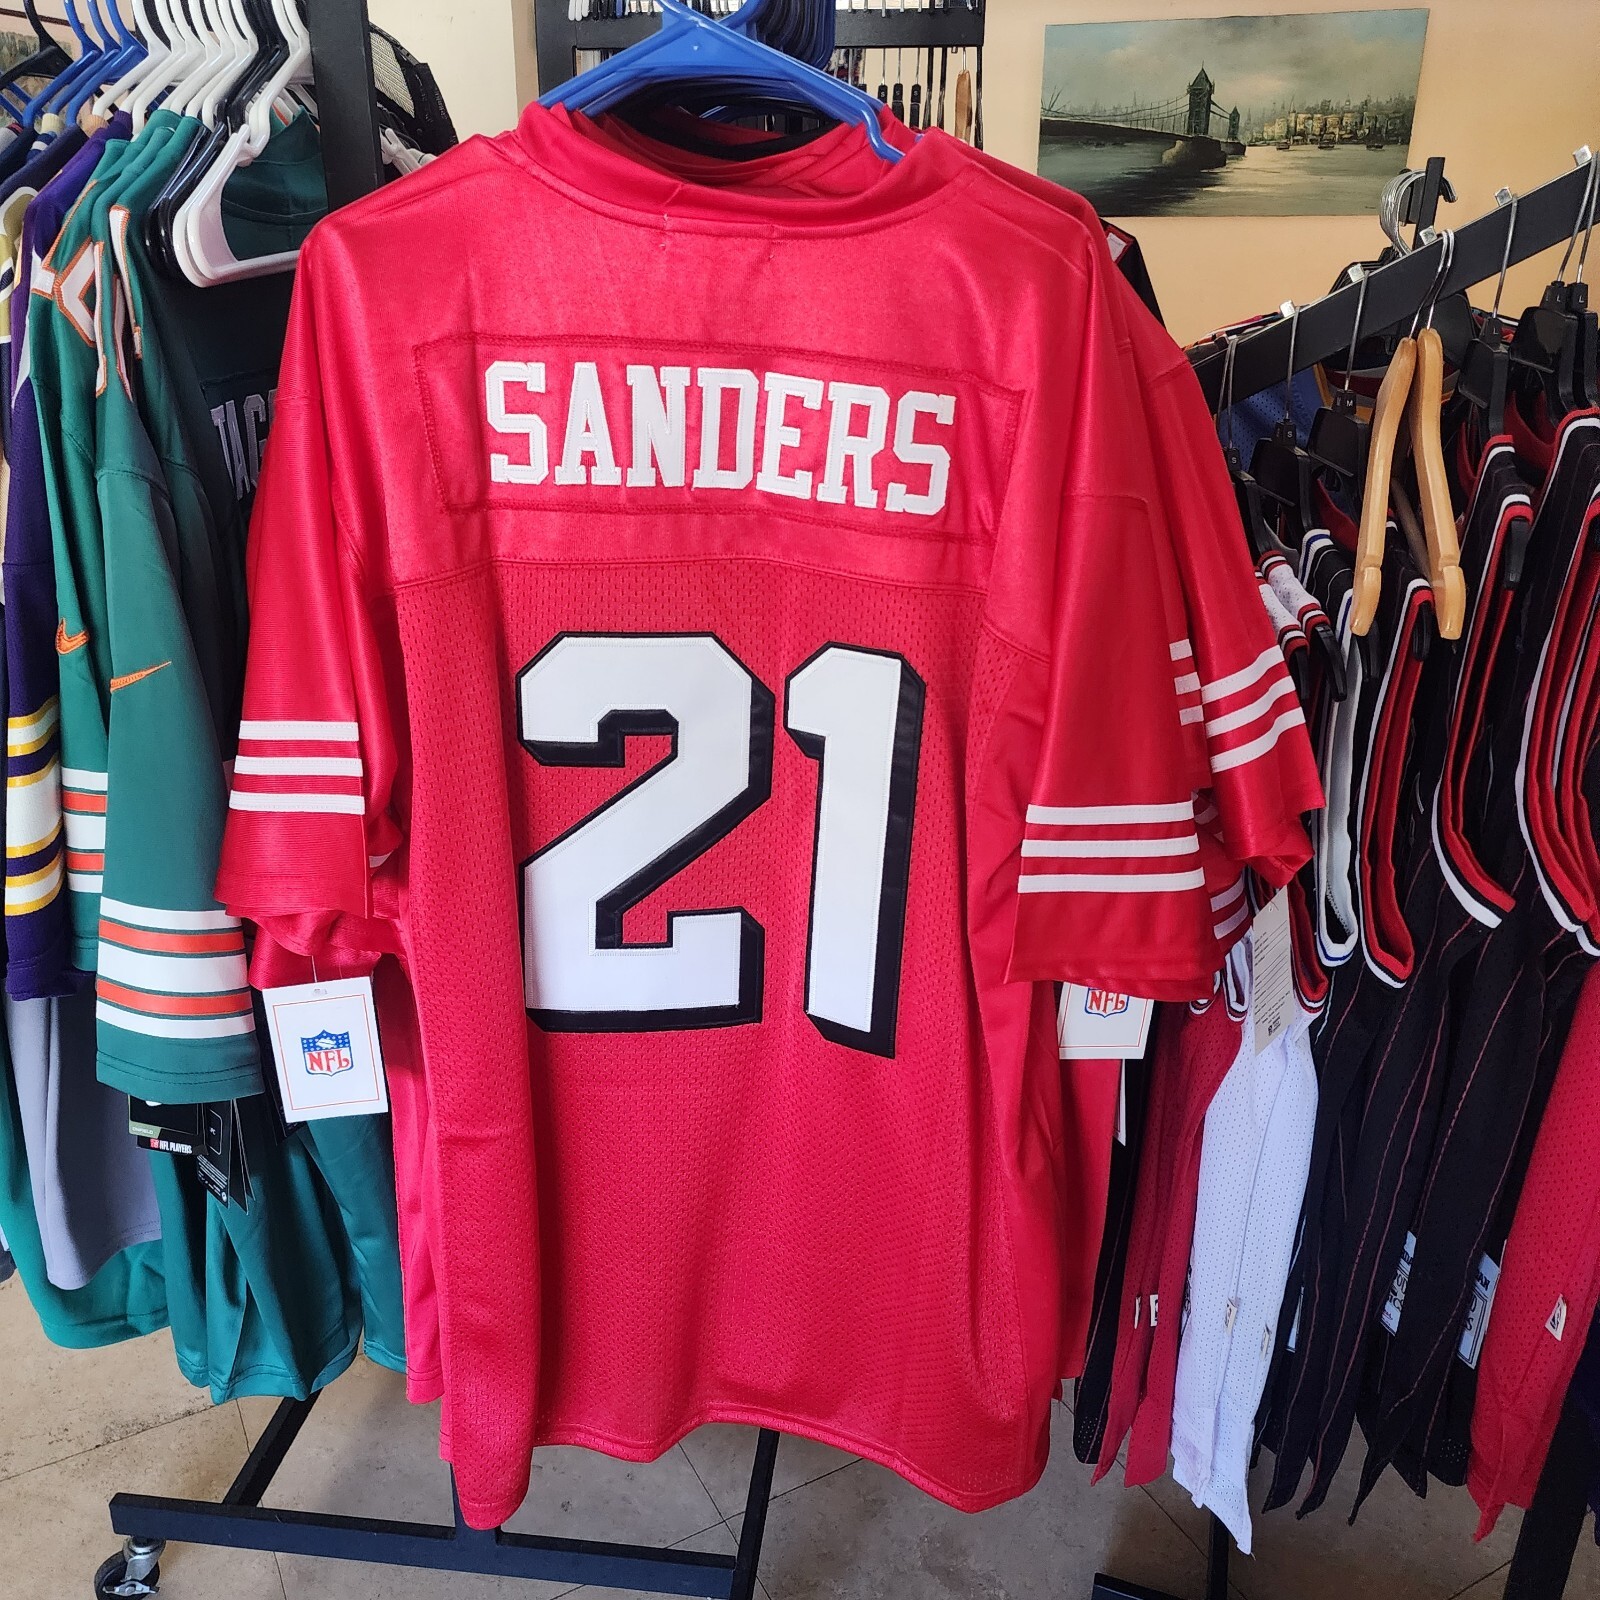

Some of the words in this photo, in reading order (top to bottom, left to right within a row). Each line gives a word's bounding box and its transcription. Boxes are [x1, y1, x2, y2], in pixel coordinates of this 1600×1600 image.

[485, 361, 956, 516] SANDERS
[515, 631, 926, 1059] 21
[1088, 990, 1125, 1014] NFL
[307, 1048, 350, 1073] NFL
